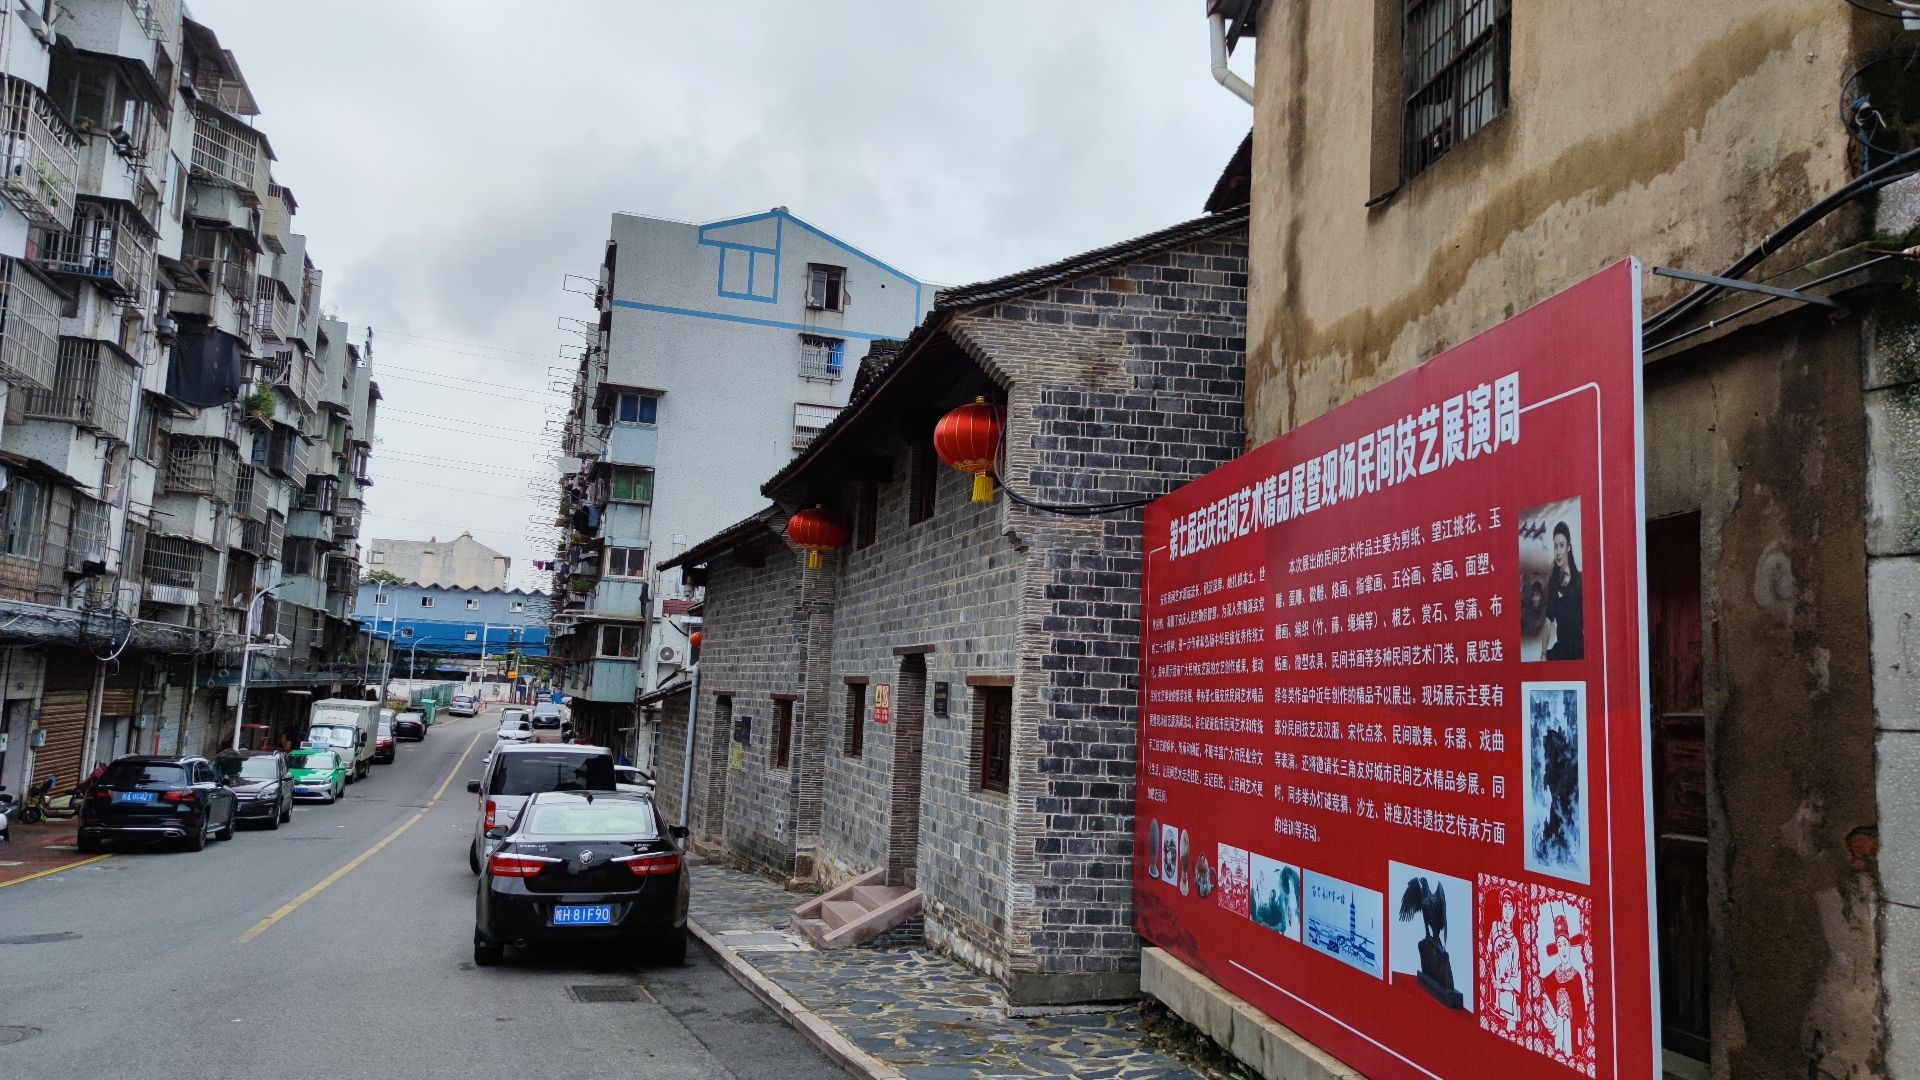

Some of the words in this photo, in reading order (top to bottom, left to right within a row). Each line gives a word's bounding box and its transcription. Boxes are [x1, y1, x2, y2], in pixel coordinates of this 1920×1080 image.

[1169, 371, 1520, 561] 第七届安庆民间艺术精品展暨现场民间技艺展演周
[1289, 507, 1501, 574] 本次展出的民间艺术作品主要为剪纸、望江挑花、玉
[1275, 640, 1503, 671] 贴画、微型农具、民间书画等多种民间艺术门类，展览选
[1275, 683, 1503, 707] 择各类作品中近年创作的精品予以展出。现场展示主要有
[1275, 719, 1504, 752] 部分民间技艺及汉服、宋代点茶、民间歌舞、乐器、戏曲
[1275, 751, 1505, 799] 等表演。还将邀请长三角友好城市民间艺术精品参展。同
[1275, 785, 1505, 846] 时，同步举办灯谜竞猜、沙龙、讲座及非遗技艺传承方面
[1275, 816, 1321, 843] 的培训等活动。
